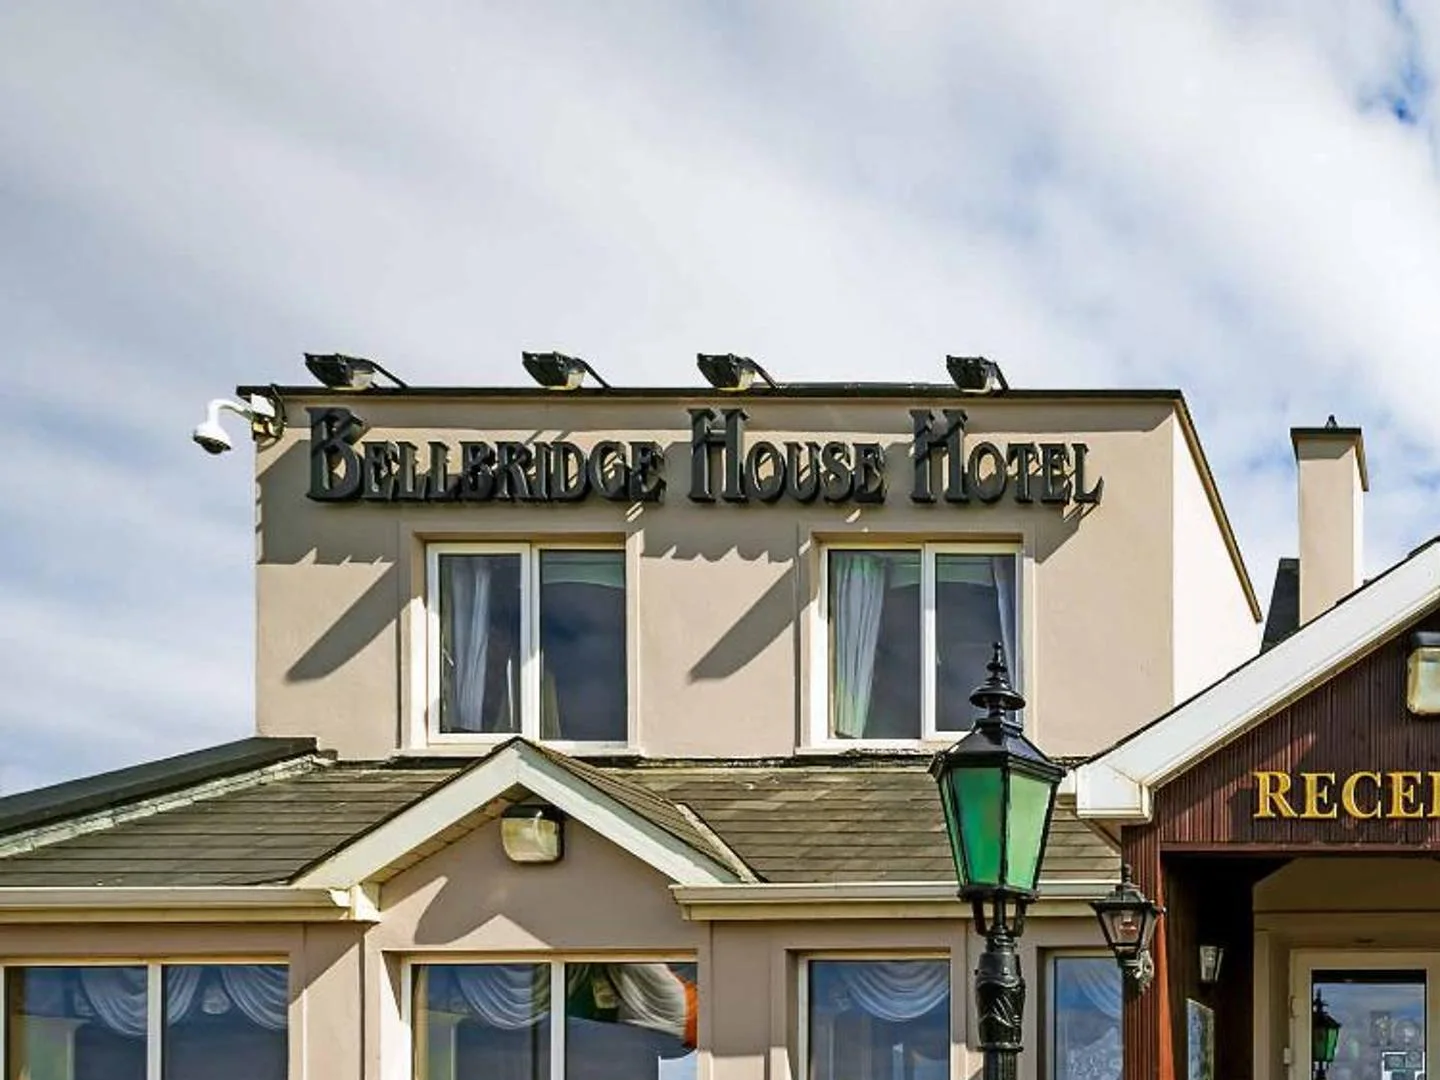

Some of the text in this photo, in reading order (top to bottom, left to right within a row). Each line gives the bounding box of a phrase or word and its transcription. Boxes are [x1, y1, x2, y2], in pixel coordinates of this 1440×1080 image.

[305, 407, 1103, 504] BELLBRIDGE HOUSE HOTEL
